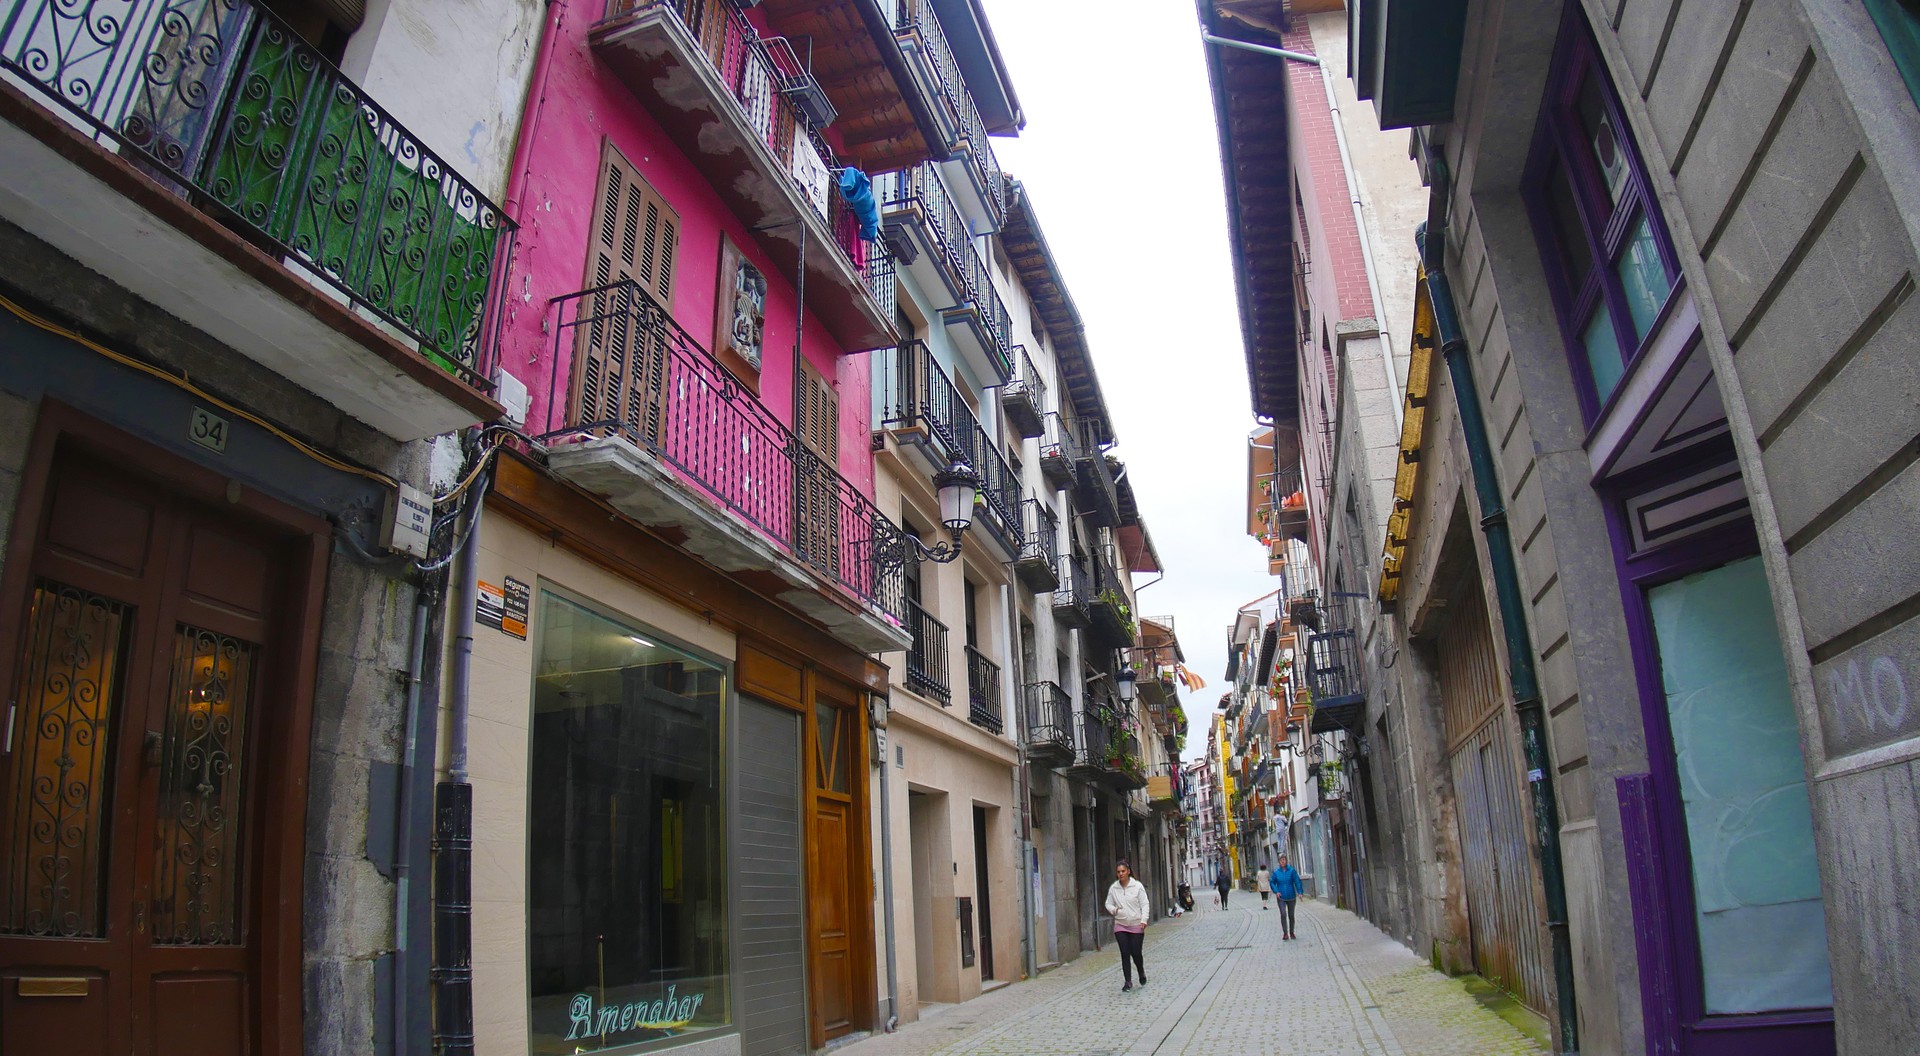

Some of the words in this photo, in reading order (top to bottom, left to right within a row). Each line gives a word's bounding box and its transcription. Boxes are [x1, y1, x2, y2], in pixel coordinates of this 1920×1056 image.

[194, 414, 222, 446] 34
[505, 579, 530, 595] segurma
[1829, 656, 1907, 741] MO
[564, 984, 704, 1041] Amenabar
